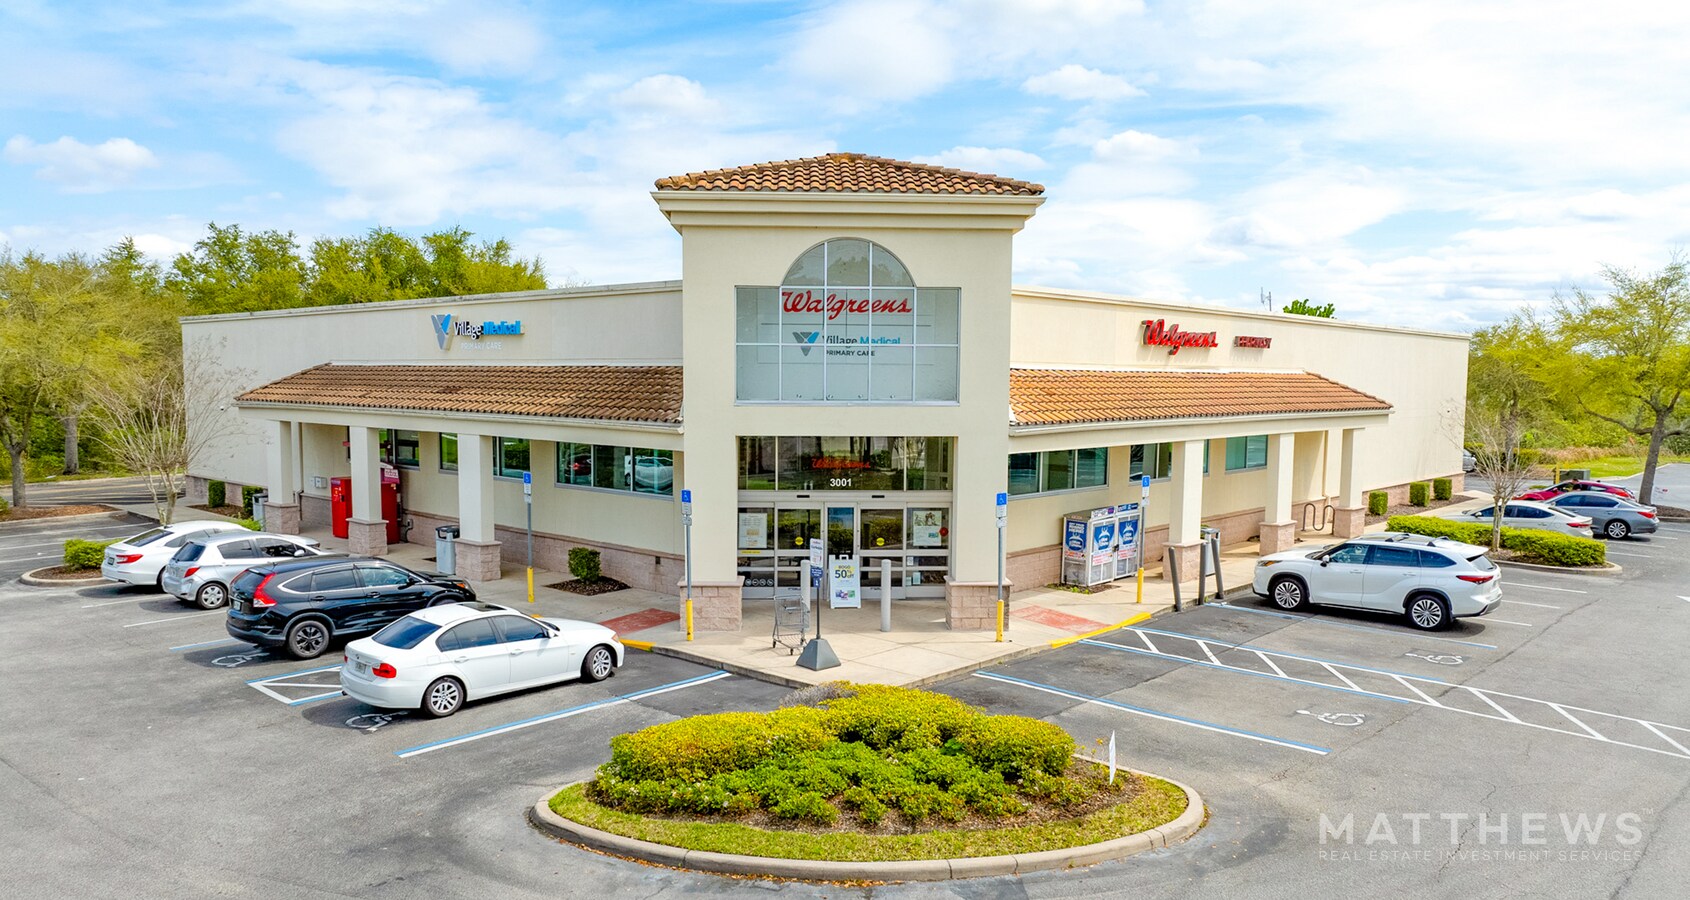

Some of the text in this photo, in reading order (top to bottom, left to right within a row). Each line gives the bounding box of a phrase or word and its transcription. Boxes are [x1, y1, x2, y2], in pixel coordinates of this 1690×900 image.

[782, 290, 912, 320] Walgreens
[454, 320, 521, 340] Village Medical
[1141, 319, 1218, 355] Walgreens
[486, 341, 502, 350] CARE
[822, 335, 857, 348] Village
[830, 478, 852, 487] 3001
